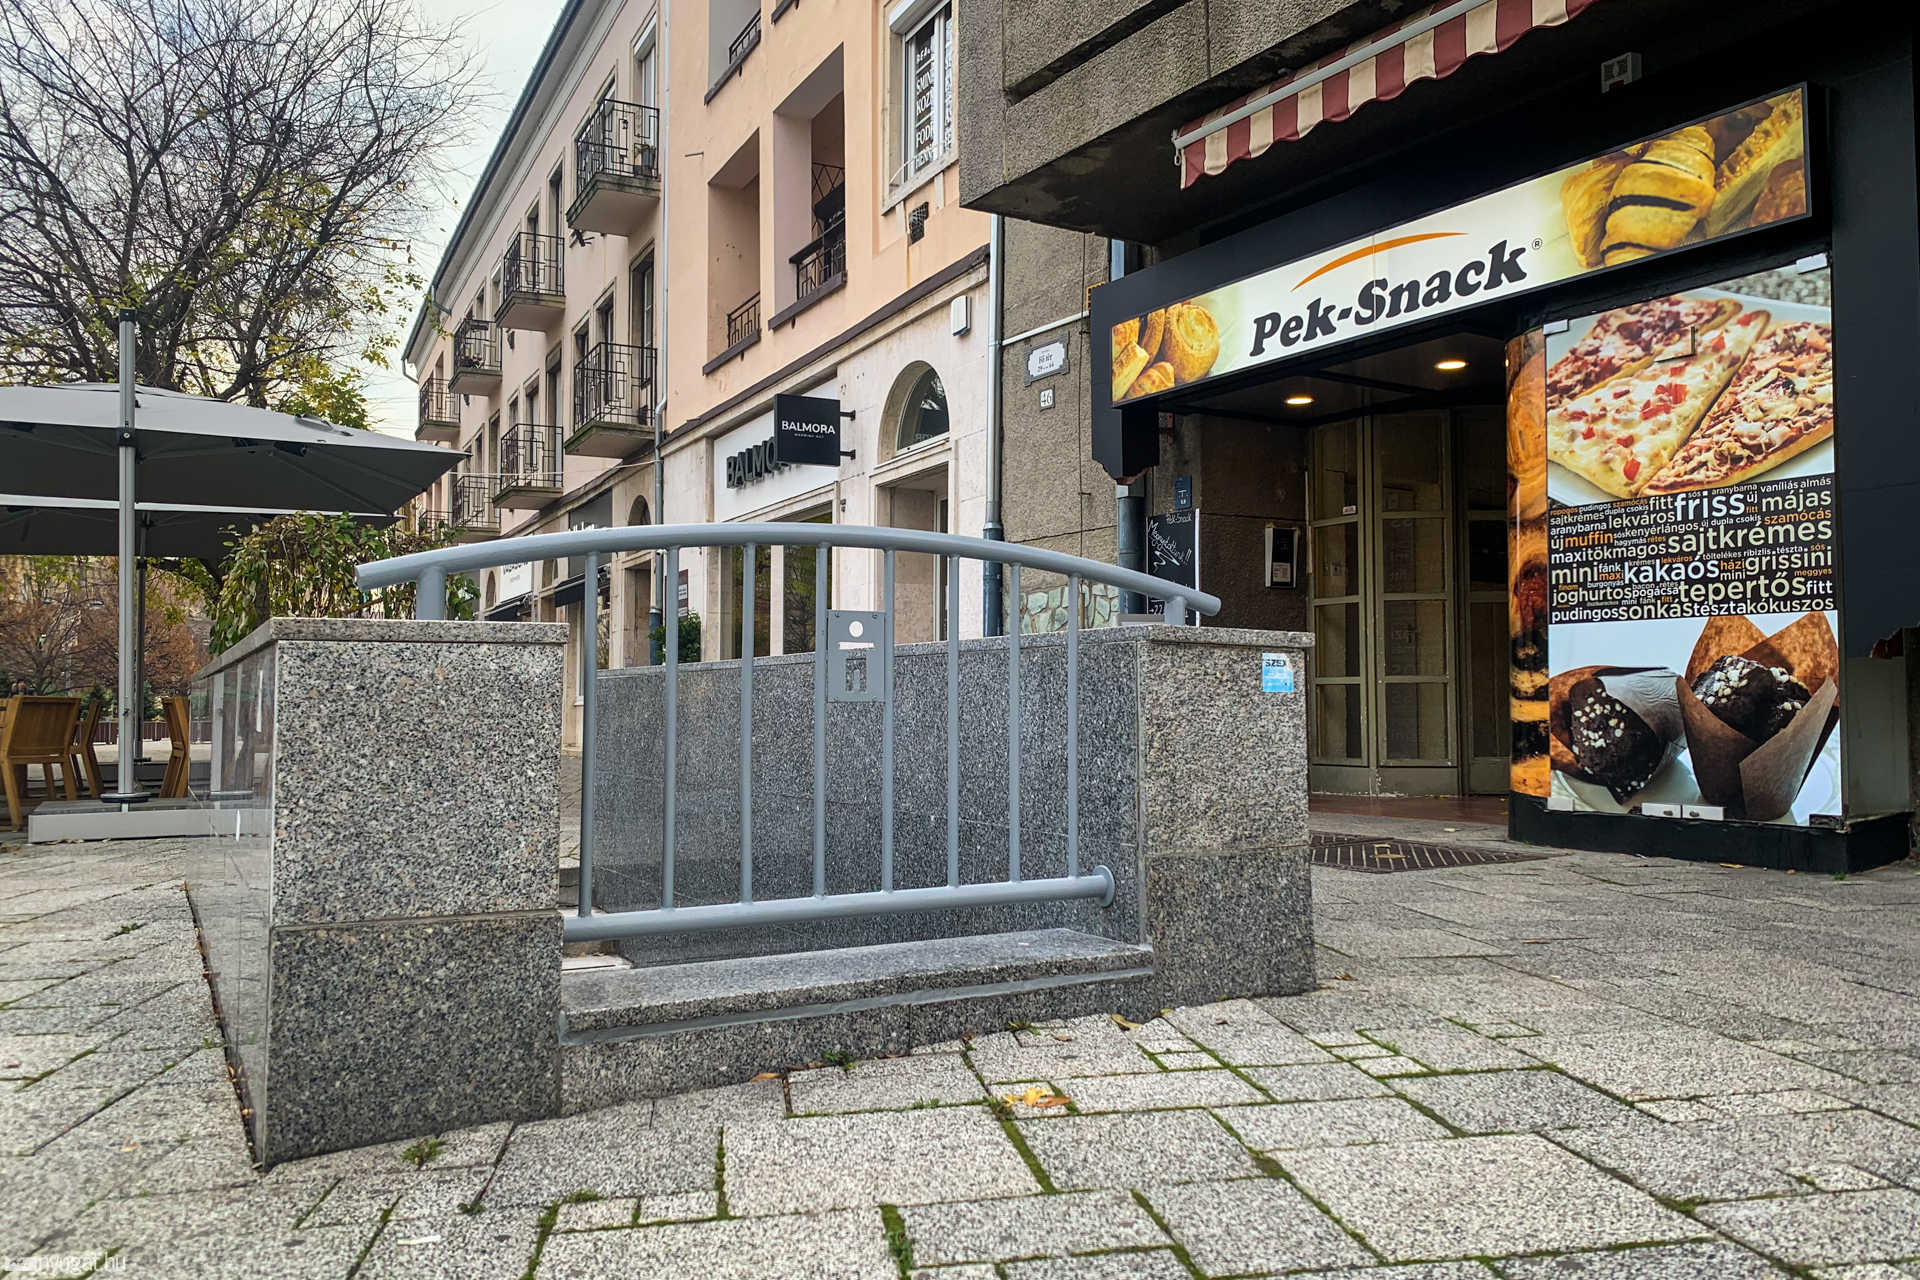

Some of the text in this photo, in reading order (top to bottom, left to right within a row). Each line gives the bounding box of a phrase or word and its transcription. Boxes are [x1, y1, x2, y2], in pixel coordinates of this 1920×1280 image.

[1250, 239, 1528, 357] Pek-Snack
[782, 420, 835, 435] BALMORA
[727, 436, 778, 488] BALMO
[1712, 483, 1757, 496] aranybarna
[1760, 477, 1832, 492] vaníliás almás
[1649, 496, 1674, 511] fitt
[1747, 491, 1758, 503] új
[1762, 489, 1832, 512] májas
[1579, 503, 1611, 513] pudingos
[1604, 507, 1625, 516] dupla
[1674, 491, 1745, 521] friss
[1550, 511, 1605, 526] sajtkrémes
[1609, 511, 1676, 529] lekváros
[1711, 517, 1734, 526] dupla
[1764, 508, 1832, 525] szamócás
[1550, 522, 1607, 535] aranybarna
[1625, 522, 1699, 538] kenyérlángos
[1551, 531, 1614, 551] új muffin
[1614, 537, 1647, 547] hagymás
[1668, 520, 1832, 555] sajtkrémes
[1551, 543, 1667, 564] maxi tökmagos
[1776, 545, 1803, 554] tészta
[1599, 562, 1621, 573] fánk
[1720, 558, 1745, 570] házi
[1745, 545, 1832, 575] grissini
[1552, 561, 1598, 585] mini
[1599, 570, 1624, 581] maxi
[1624, 555, 1720, 584] kakaós
[1720, 568, 1746, 581] mini
[1794, 568, 1833, 577] meggyes
[1678, 571, 1833, 605] tepertős fitt
[1552, 586, 1679, 606] joghurtos pogácsa
[1552, 597, 1834, 623] pudingos sonkás tészta kókuszos
